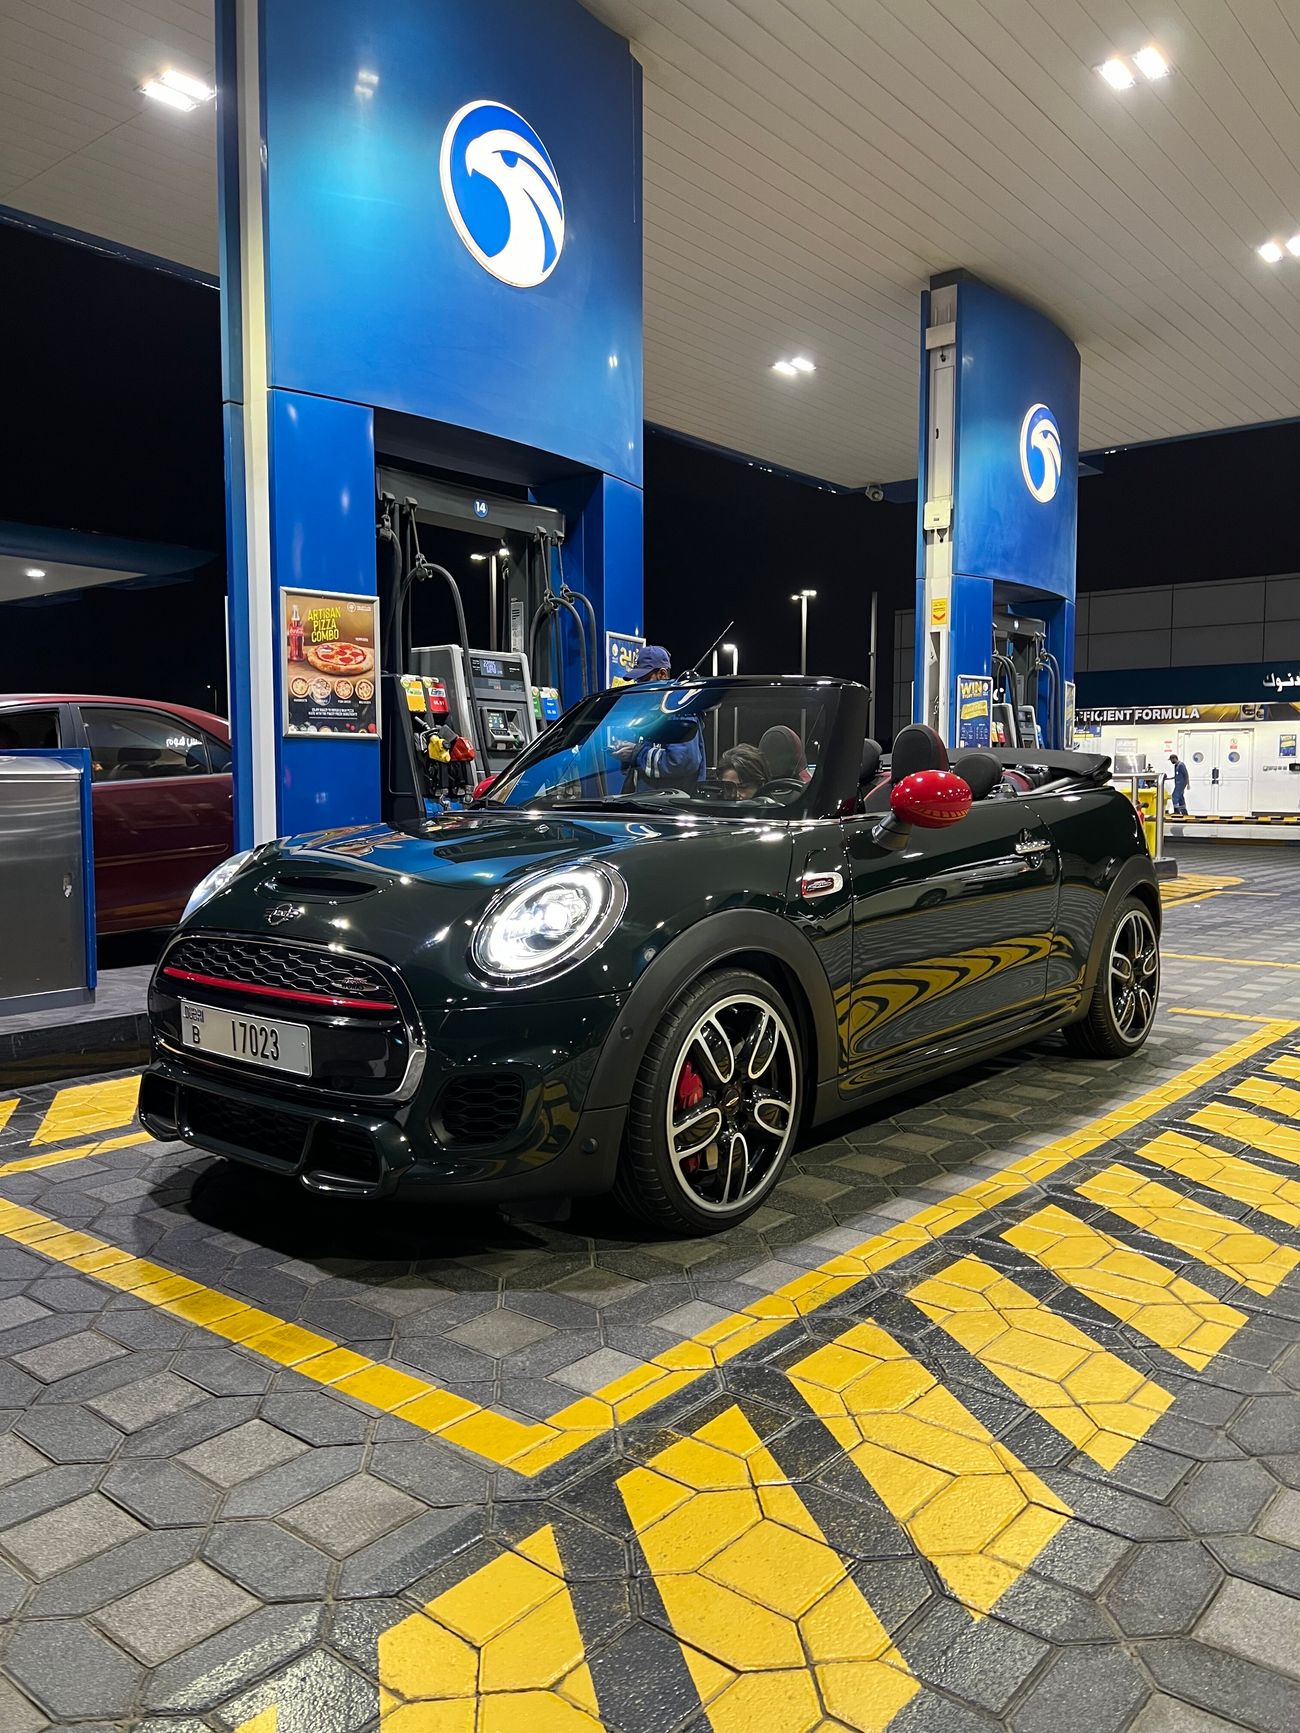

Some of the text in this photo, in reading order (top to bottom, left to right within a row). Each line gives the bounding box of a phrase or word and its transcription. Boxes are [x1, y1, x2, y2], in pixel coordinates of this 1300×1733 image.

[476, 501, 487, 514] 14
[307, 607, 341, 620] ARTISAN
[313, 618, 337, 631] PIZZA
[311, 629, 340, 643] COMBO
[961, 681, 983, 696] WIN
[1074, 707, 1200, 722] FFICIENT FORMULA
[192, 1019, 280, 1061] B 17023
